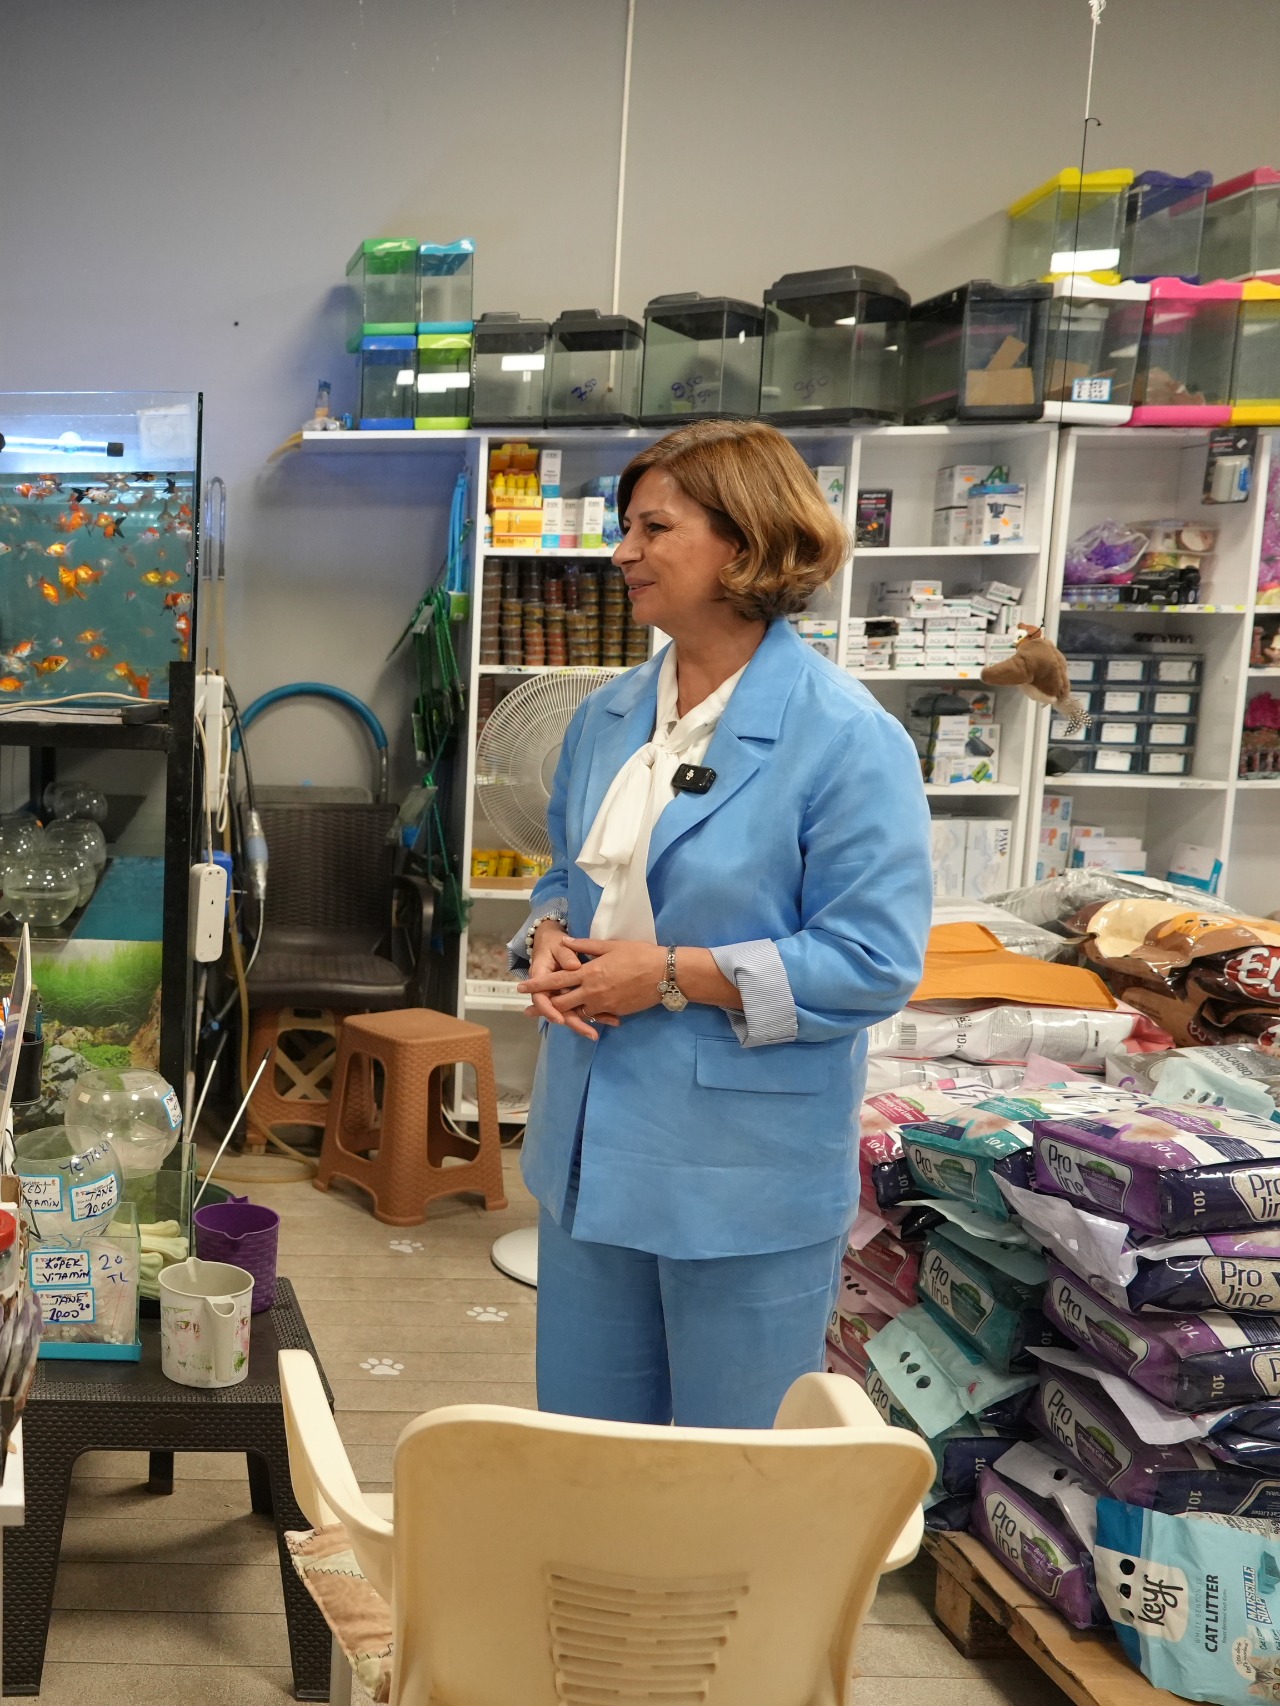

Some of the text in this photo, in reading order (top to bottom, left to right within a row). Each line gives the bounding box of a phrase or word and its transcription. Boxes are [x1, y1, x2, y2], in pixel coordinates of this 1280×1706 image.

[915, 1149, 933, 1173] Pro
[1049, 1144, 1072, 1173] Pro
[1056, 1168, 1085, 1196] line
[1192, 1190, 1206, 1216] 10L
[1260, 1196, 1280, 1219] lin
[930, 1256, 949, 1287] Pro
[1220, 1260, 1263, 1287] Pro
[1059, 1286, 1082, 1321] Pro
[1225, 1284, 1274, 1308] line
[871, 1378, 889, 1409] Pro
[1210, 1374, 1226, 1398] 10L
[1048, 1388, 1073, 1425] Pro
[992, 1500, 1017, 1537] Pro
[995, 1524, 1020, 1564] line
[1243, 1565, 1258, 1620] MARSEILLE
[1204, 1574, 1219, 1653] CAT LITTER
[1255, 1597, 1273, 1624] SOAP
